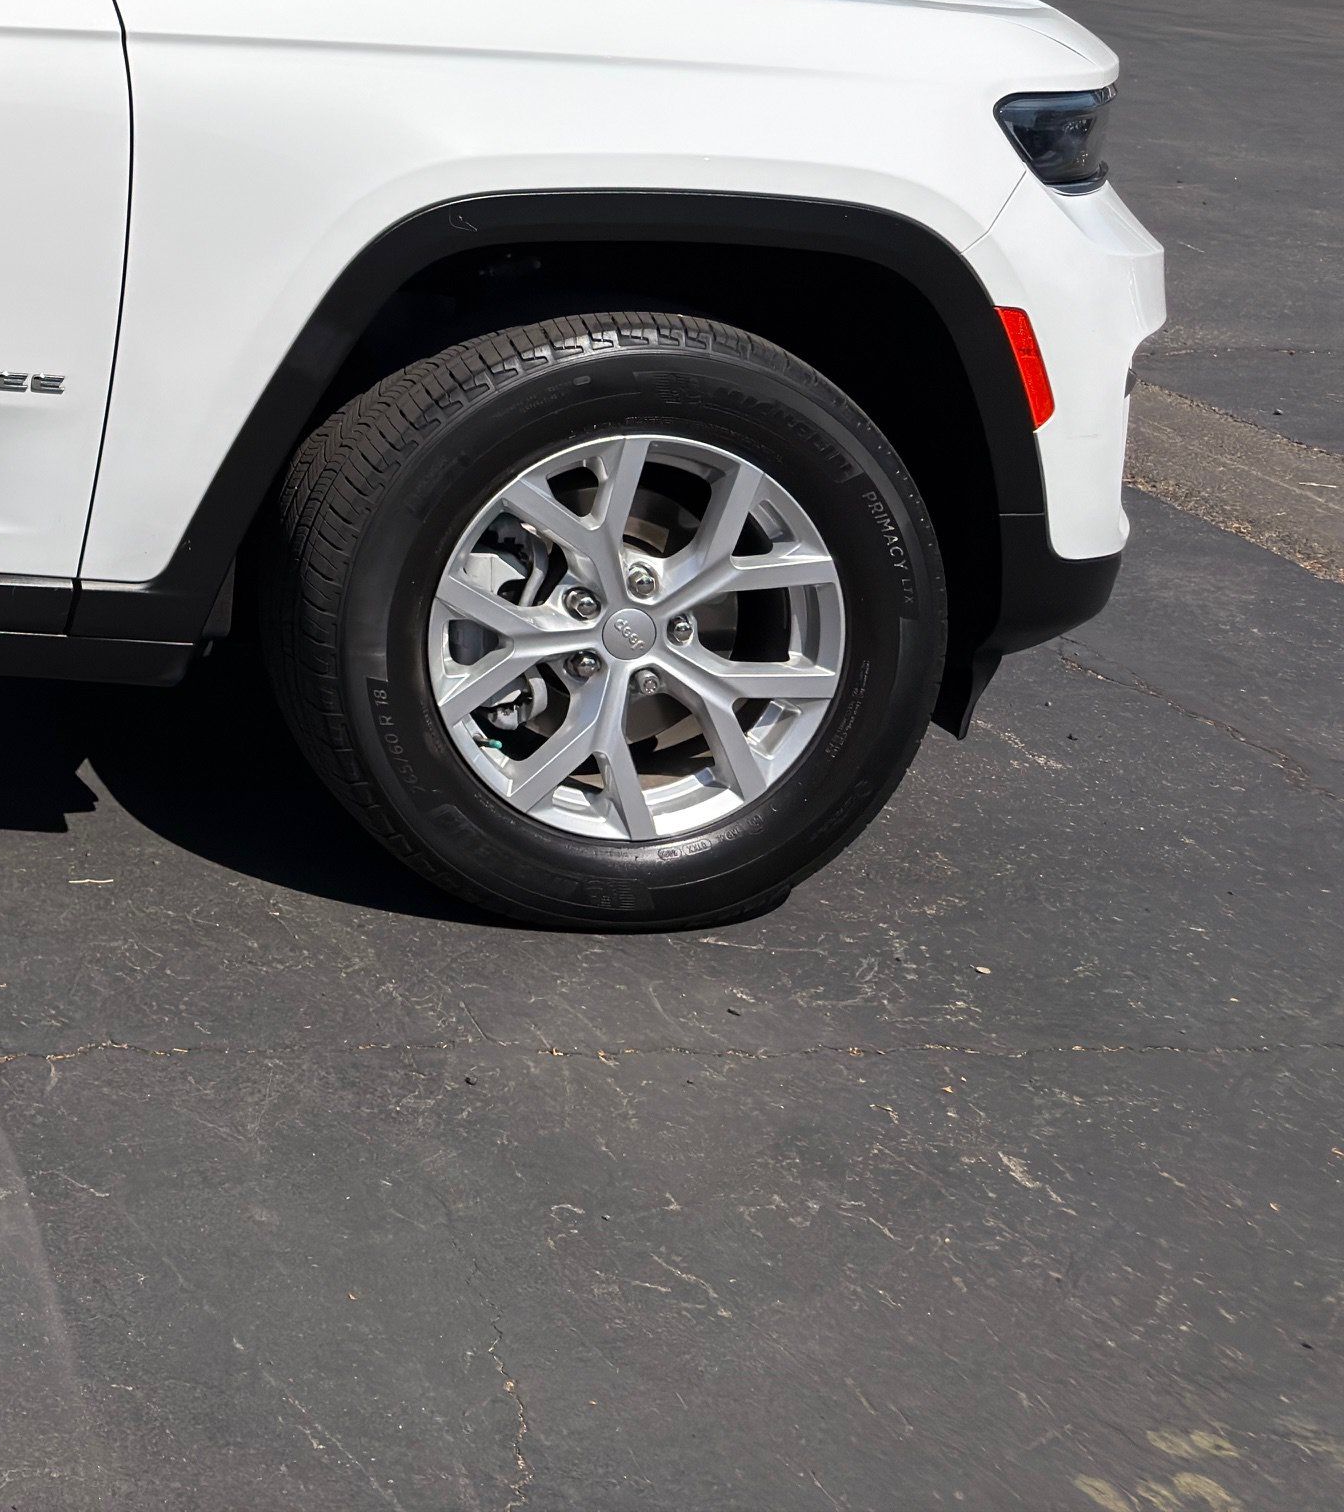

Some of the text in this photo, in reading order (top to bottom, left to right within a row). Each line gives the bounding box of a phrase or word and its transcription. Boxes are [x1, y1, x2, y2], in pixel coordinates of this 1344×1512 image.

[861, 490, 914, 603] PRIMACY LTX
[373, 688, 389, 706] 18
